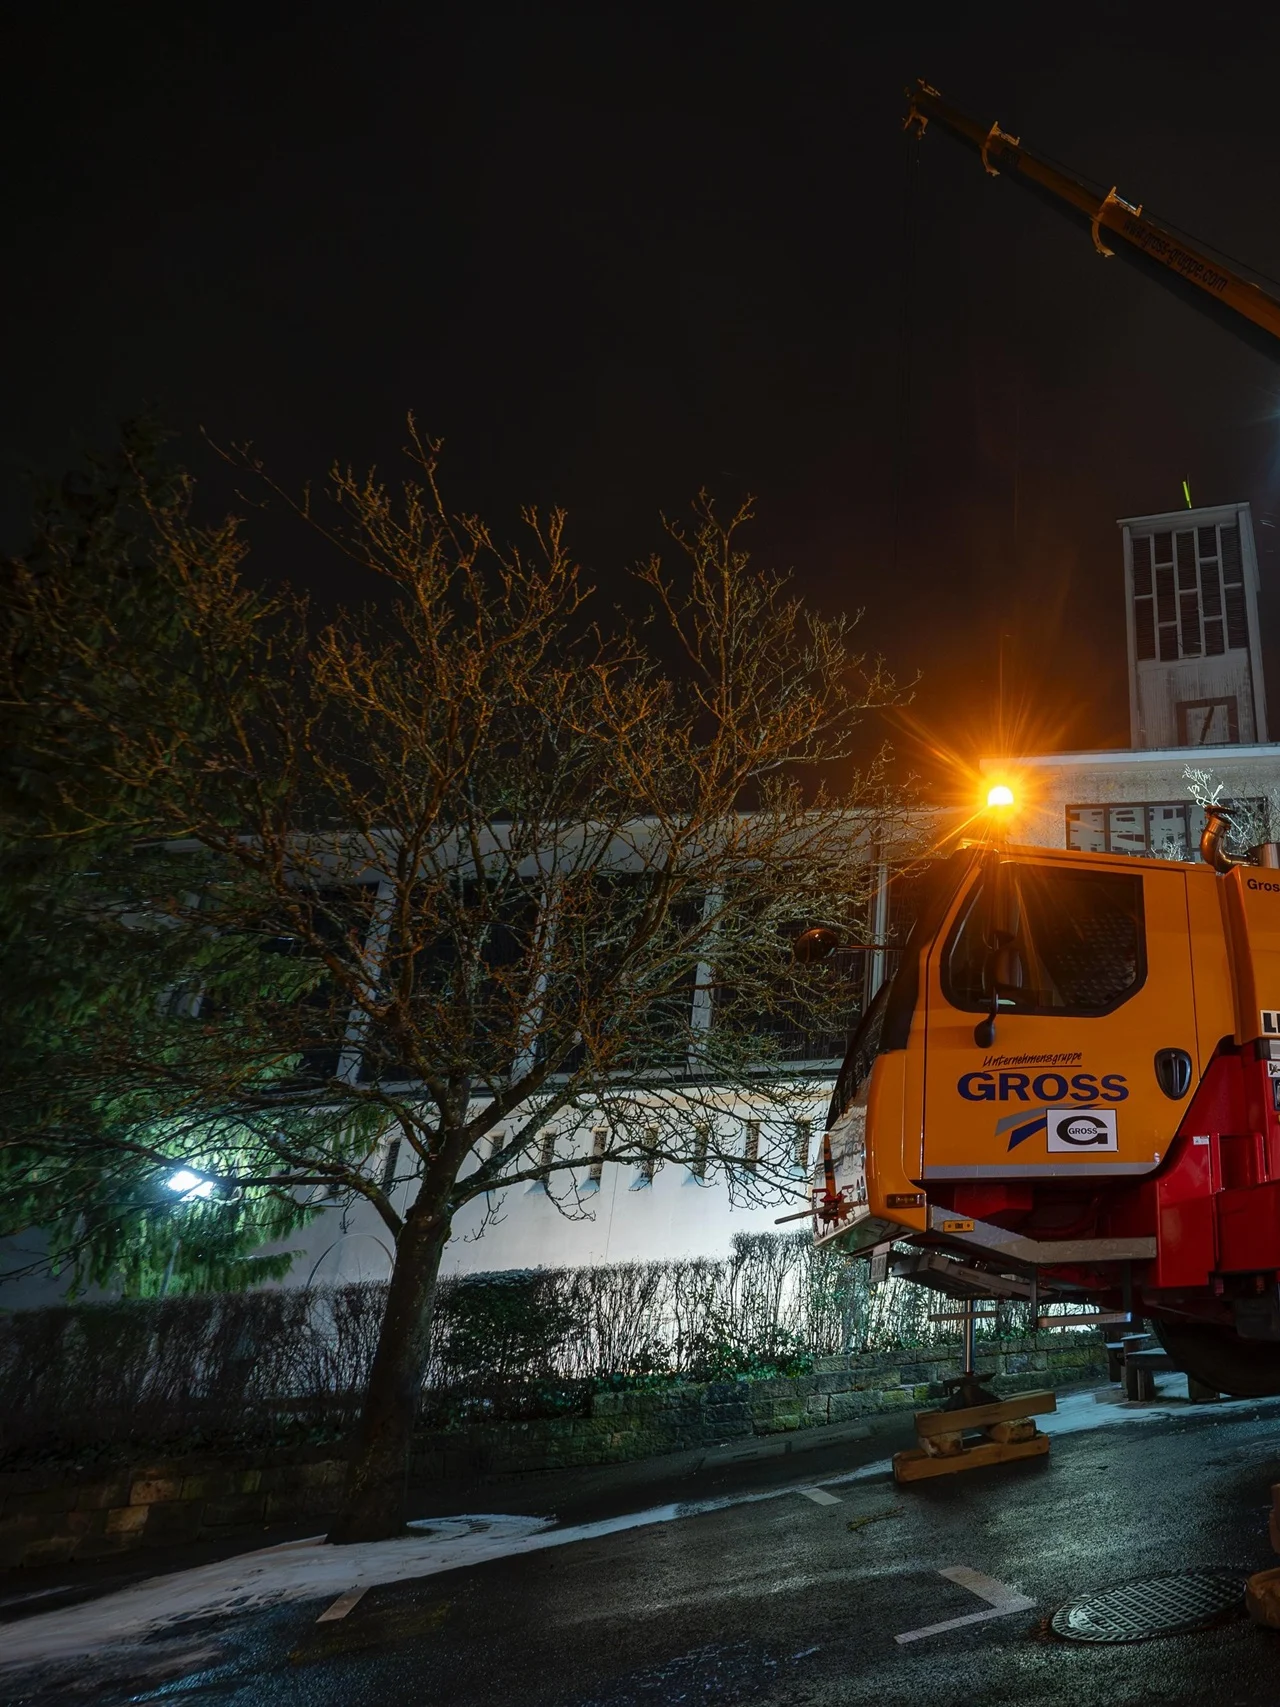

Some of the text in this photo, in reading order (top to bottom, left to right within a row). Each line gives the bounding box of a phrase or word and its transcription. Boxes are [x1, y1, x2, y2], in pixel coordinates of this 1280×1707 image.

[982, 1051, 1083, 1068] Unternehmensgruppe
[957, 1072, 1130, 1102] GROSS
[1068, 1127, 1098, 1135] GROSS
